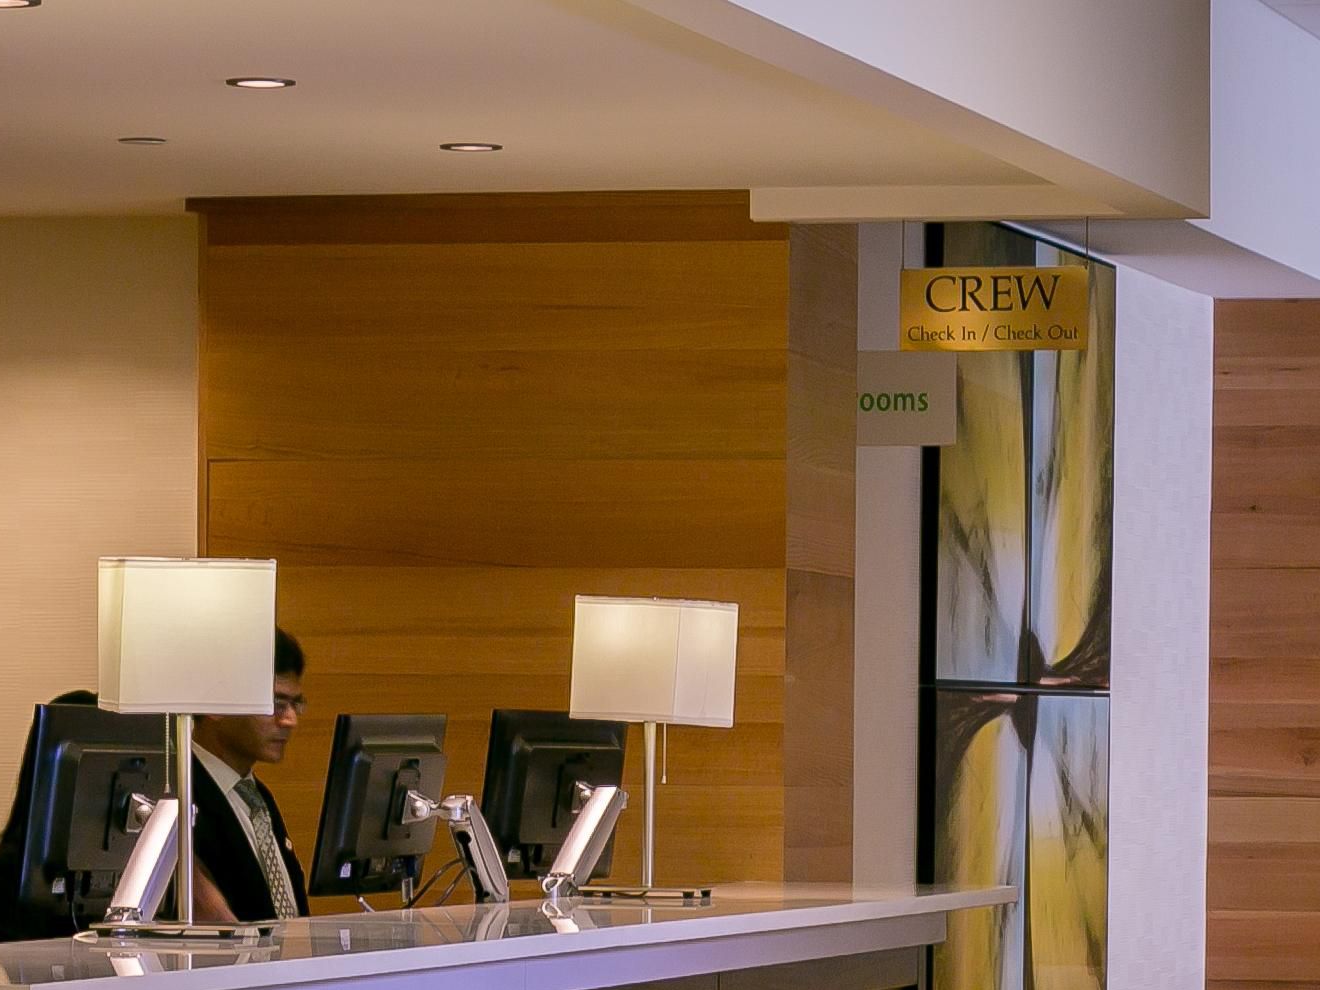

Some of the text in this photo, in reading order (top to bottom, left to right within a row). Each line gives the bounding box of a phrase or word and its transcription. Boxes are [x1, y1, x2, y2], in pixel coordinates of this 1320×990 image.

[925, 275, 1061, 313] CREW
[907, 324, 1078, 342] Check In / Check Out
[856, 392, 928, 412] ooms
